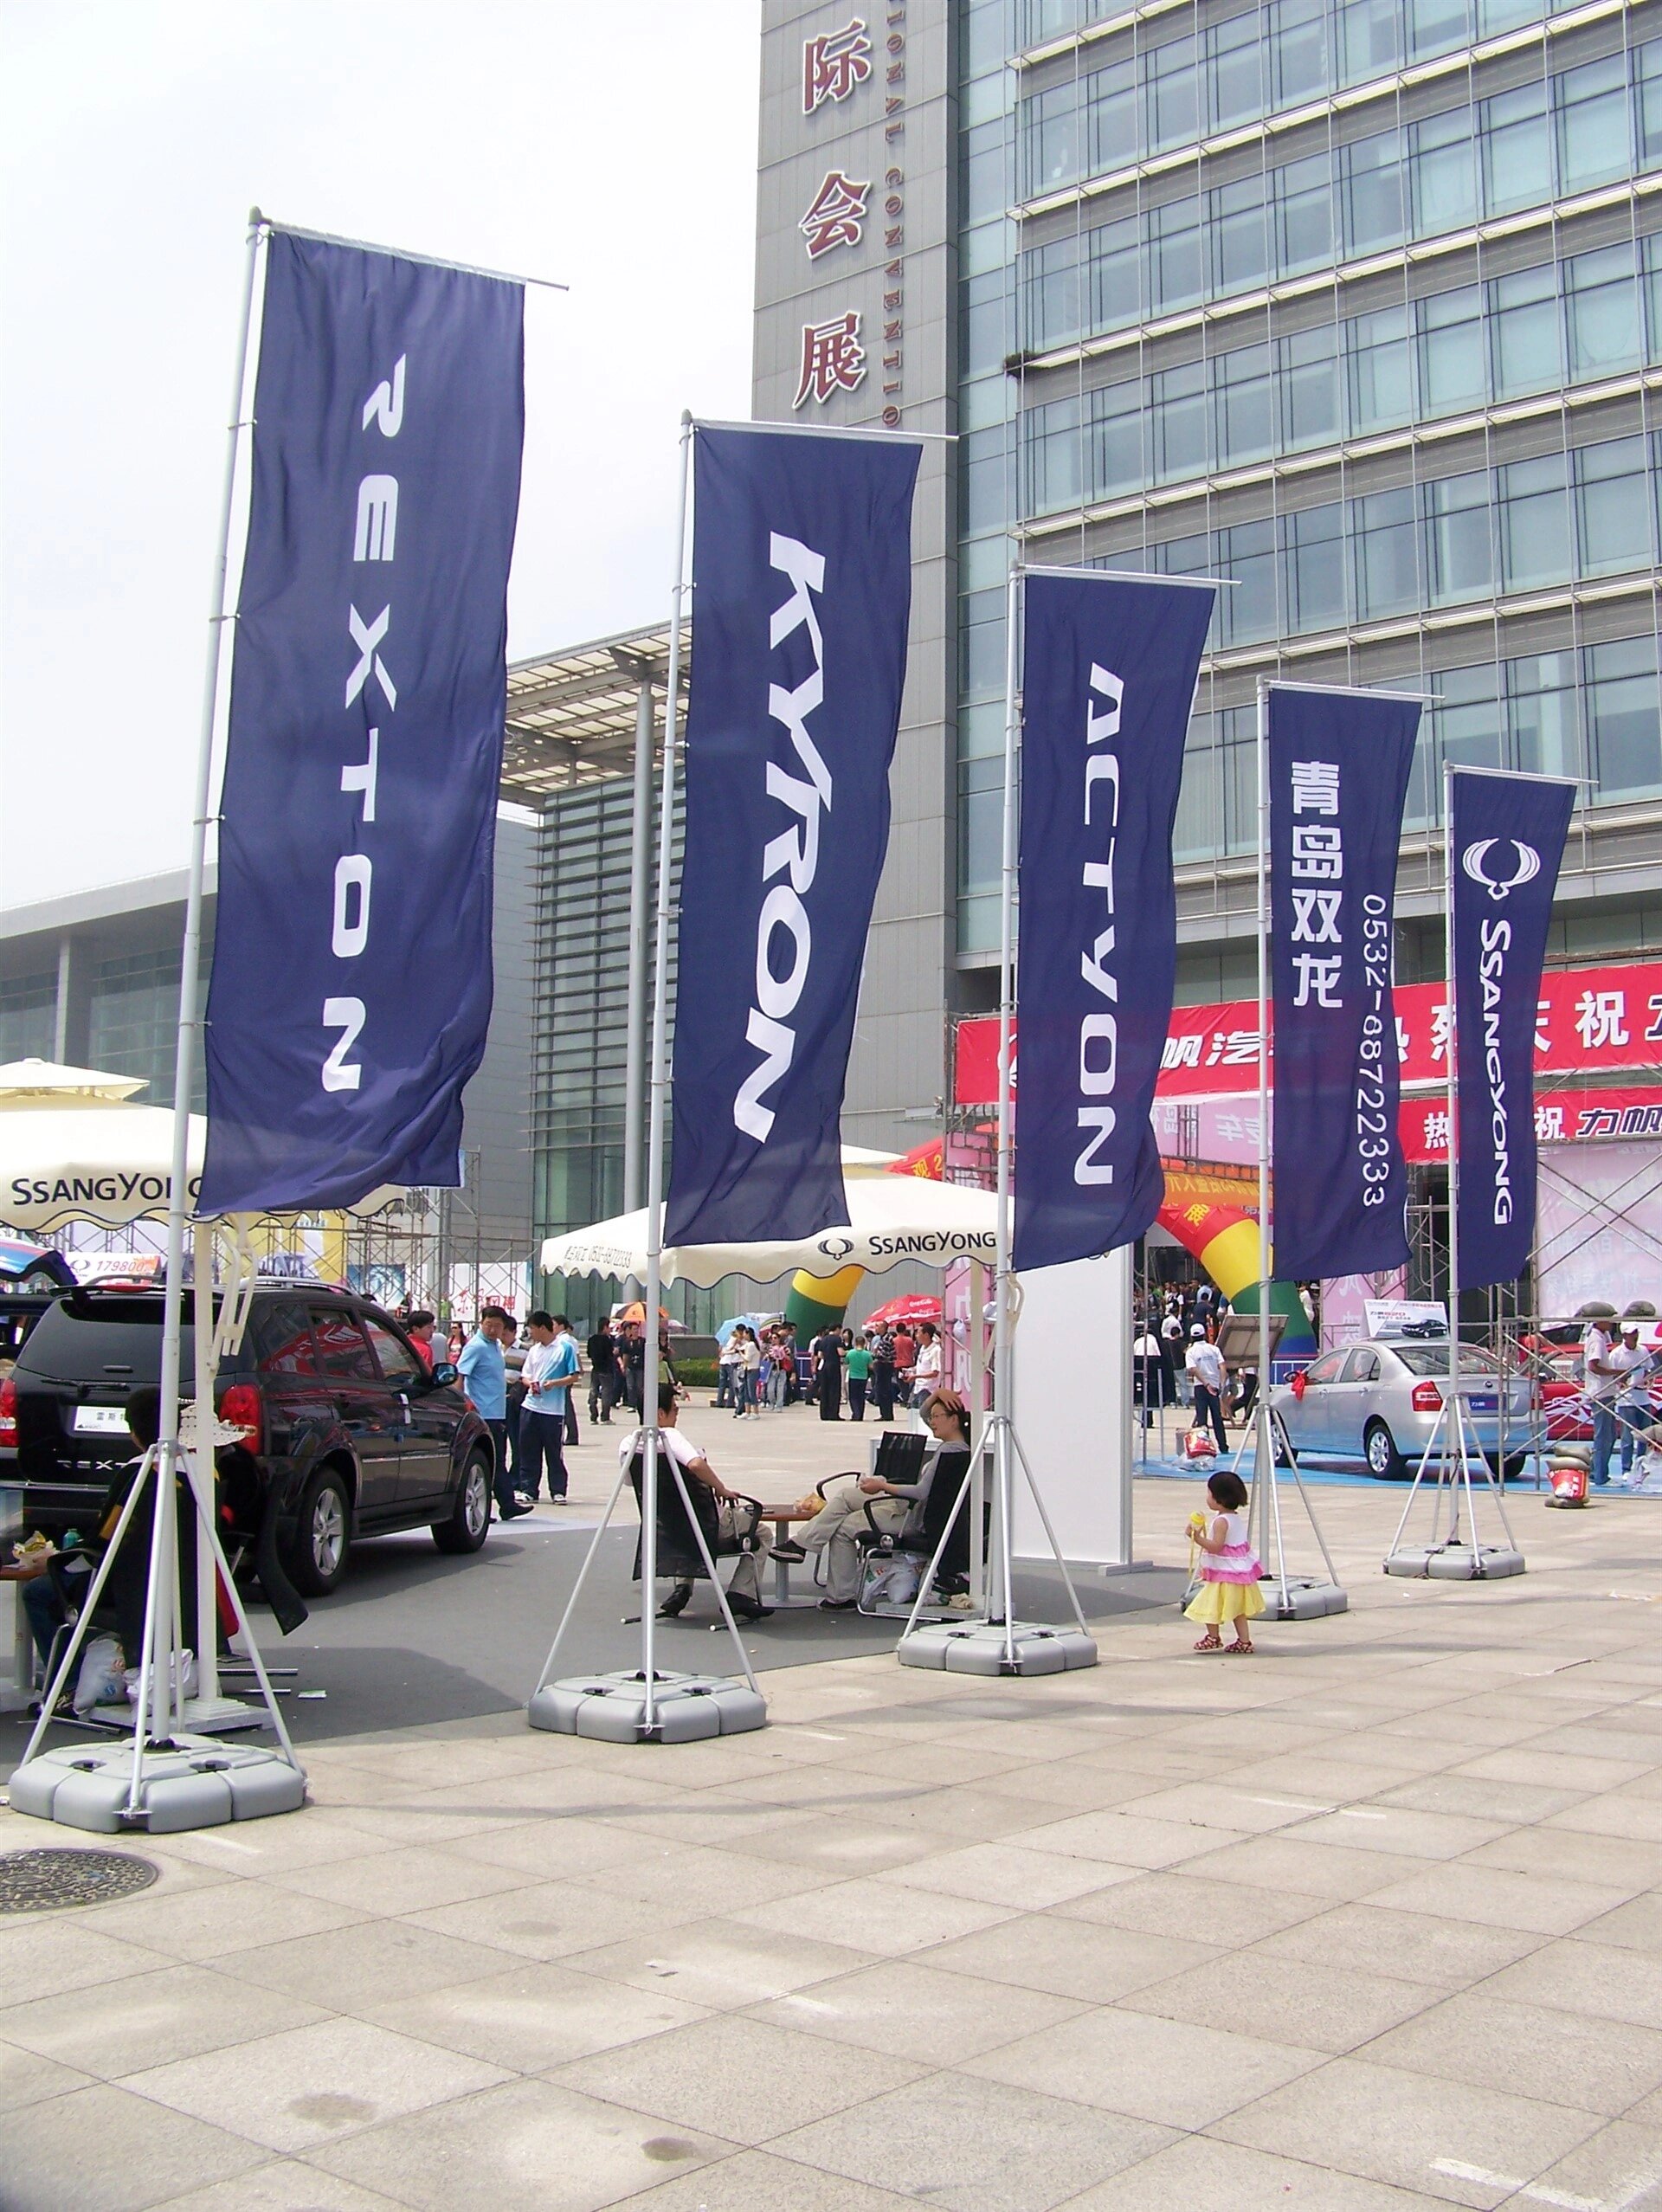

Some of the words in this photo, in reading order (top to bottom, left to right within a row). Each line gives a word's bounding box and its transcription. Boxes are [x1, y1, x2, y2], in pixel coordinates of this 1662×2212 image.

[321, 352, 407, 1093] REXTON
[733, 531, 832, 1144] KYRON
[1073, 661, 1124, 1185] ACTYON
[1291, 760, 1343, 1008] 青岛双龙
[1356, 893, 1389, 1207] 0532-88722333
[1478, 918, 1513, 1225] SSANGYONG
[868, 1231, 996, 1255] SSANGYONG
